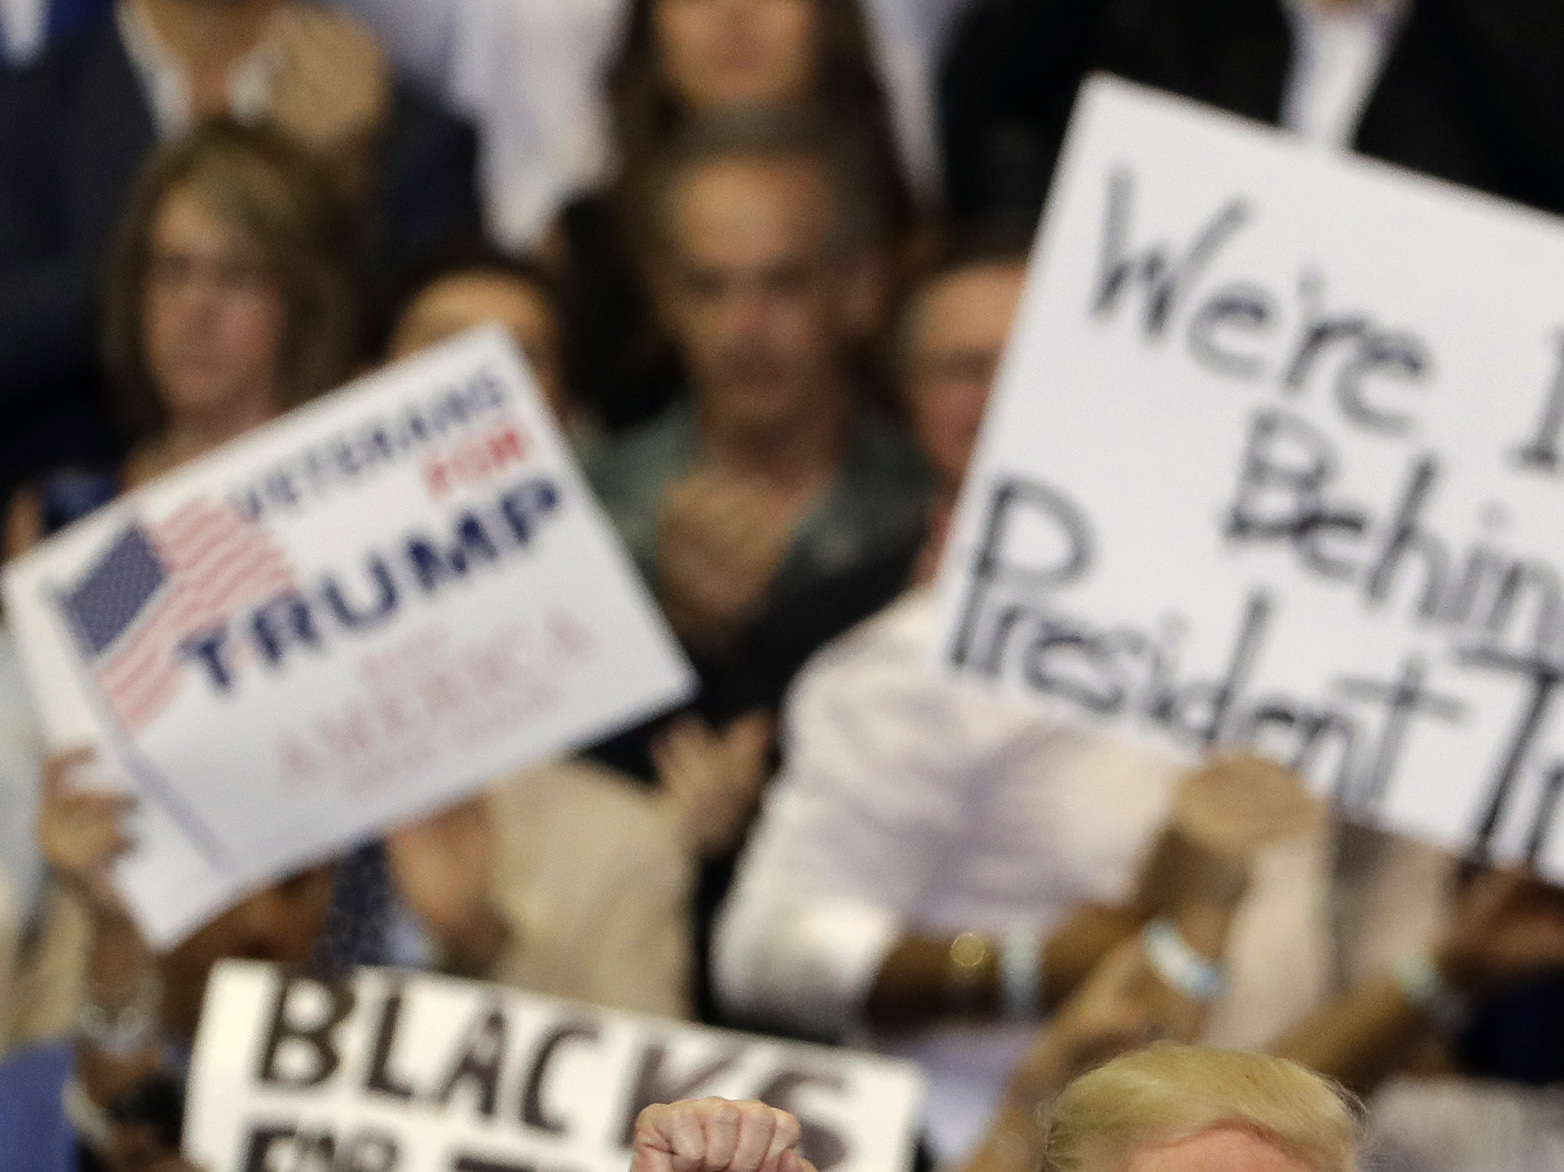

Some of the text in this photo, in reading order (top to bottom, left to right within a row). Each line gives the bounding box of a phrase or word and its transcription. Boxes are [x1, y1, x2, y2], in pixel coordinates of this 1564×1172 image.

[1090, 164, 1432, 434] We're
[232, 362, 514, 522] VETERANS
[422, 426, 532, 502] FOR
[180, 474, 562, 696] TRUMP
